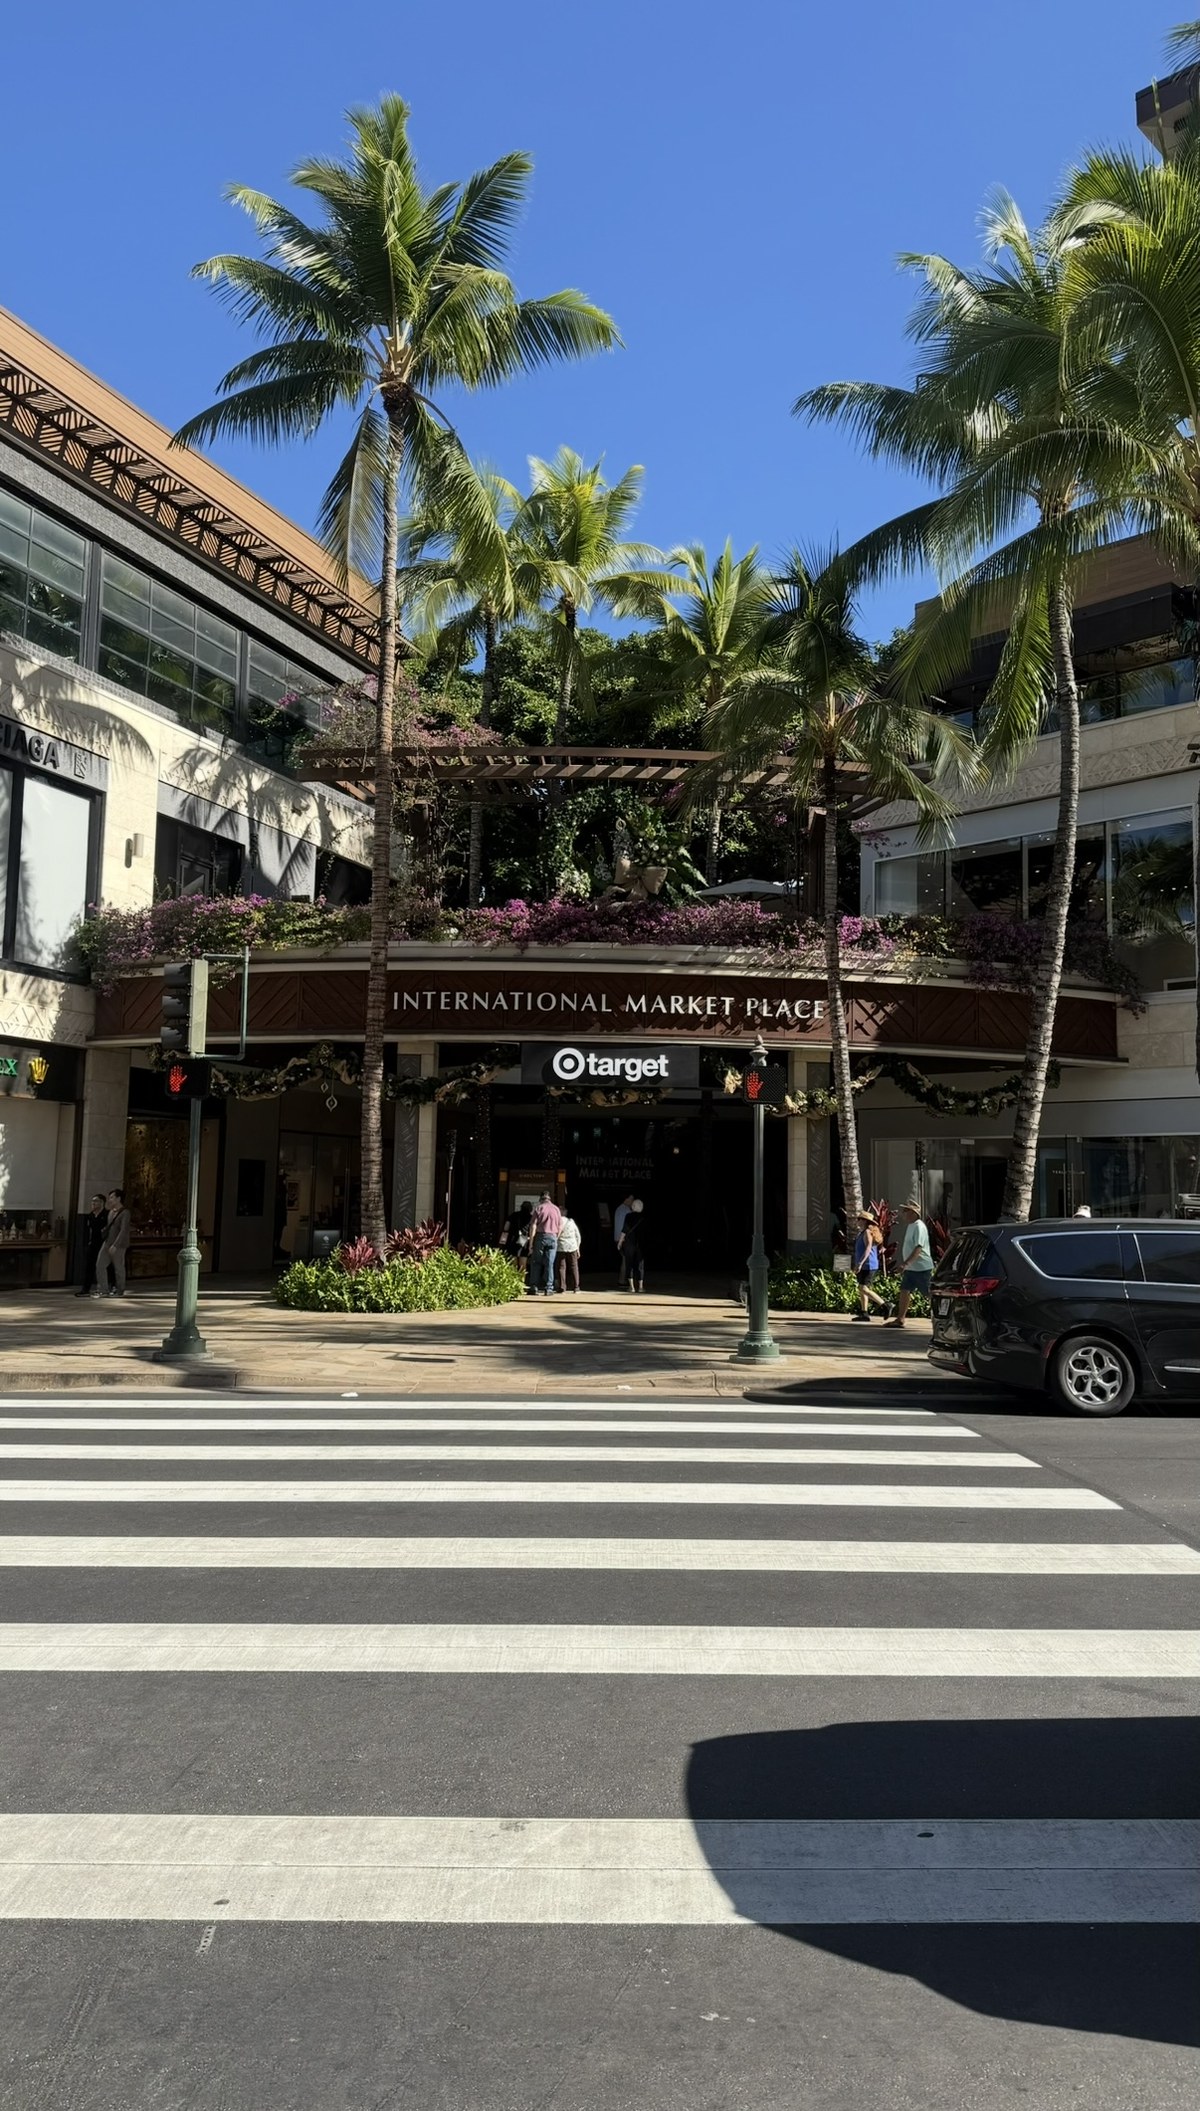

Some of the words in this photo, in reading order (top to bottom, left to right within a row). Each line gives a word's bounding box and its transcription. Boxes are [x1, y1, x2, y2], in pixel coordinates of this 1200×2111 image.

[0, 721, 60, 769] IAGA
[393, 991, 612, 1012] INTERNATIONAL
[625, 994, 735, 1016] MARKET
[746, 997, 825, 1019] PLACE
[586, 1053, 669, 1082] target
[578, 1167, 620, 1179] MAET
